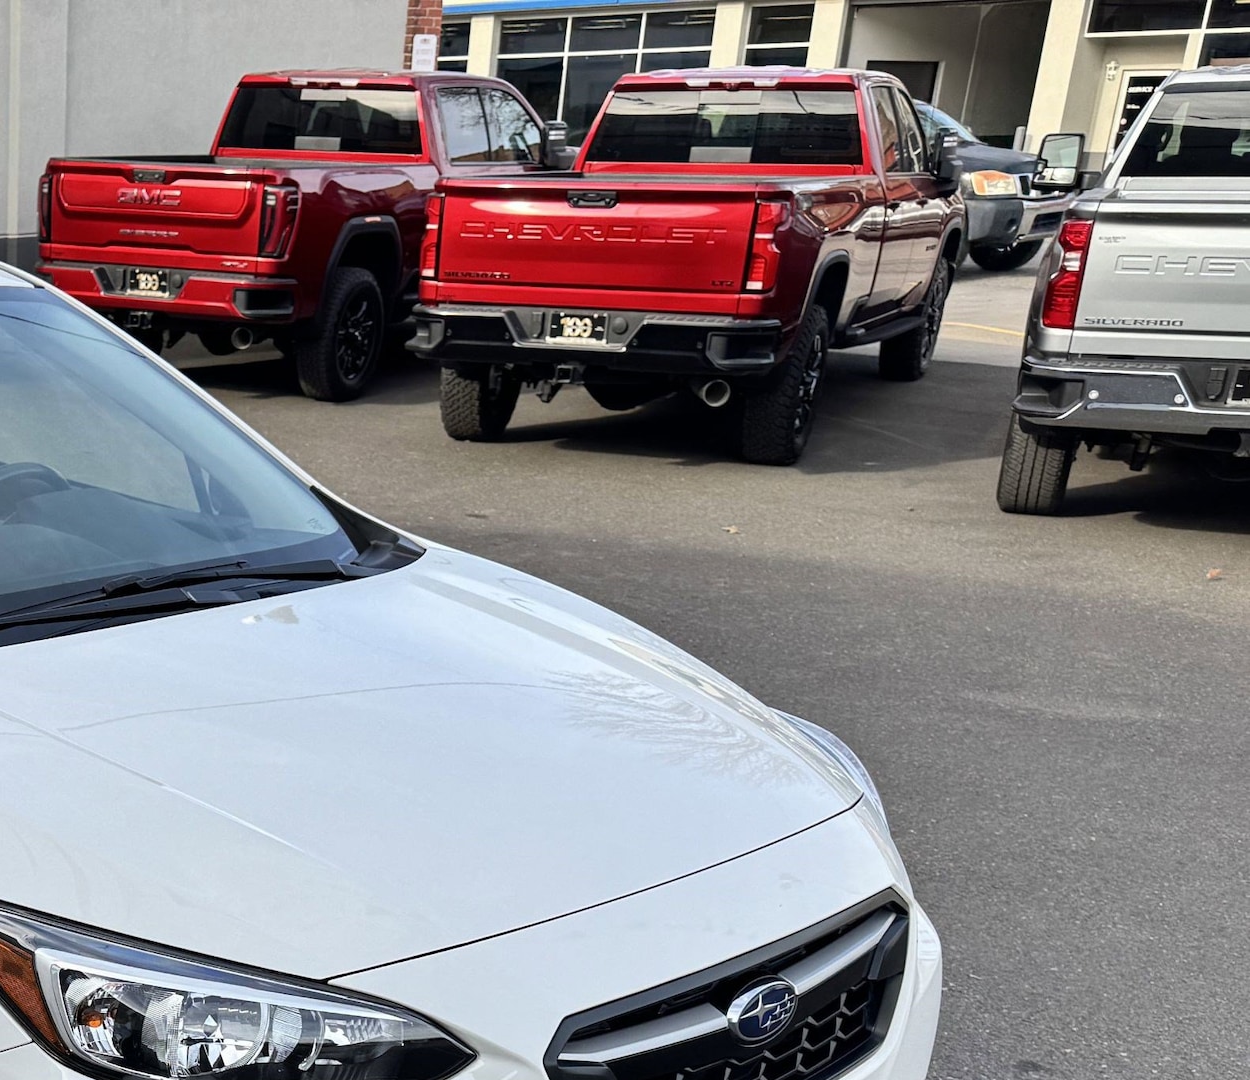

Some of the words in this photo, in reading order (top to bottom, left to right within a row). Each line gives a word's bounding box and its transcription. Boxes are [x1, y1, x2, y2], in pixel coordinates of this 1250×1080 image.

[117, 188, 181, 206] GMC
[460, 221, 728, 245] CHEVROLET
[1084, 317, 1184, 327] SILVERADO
